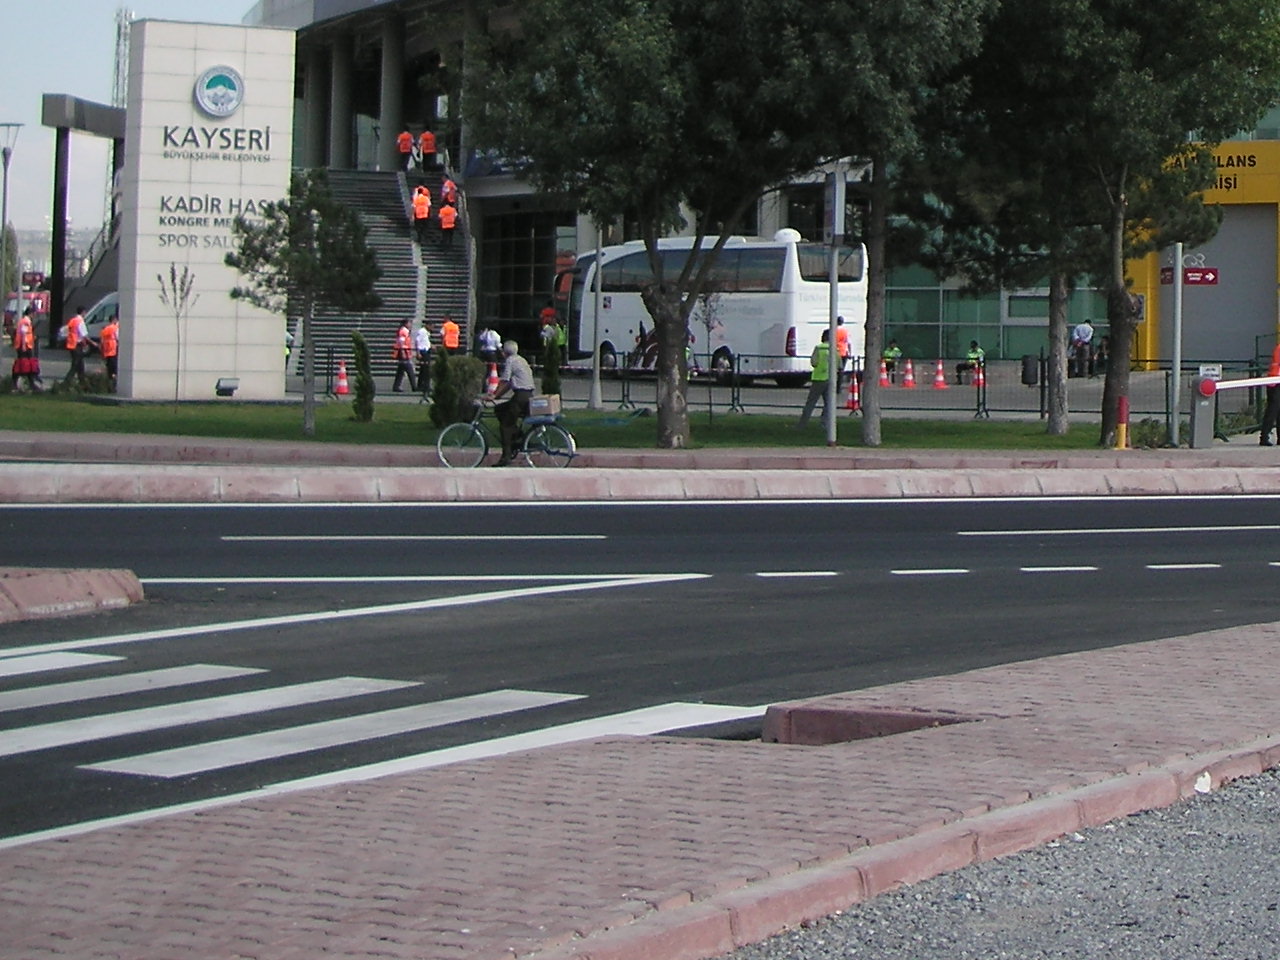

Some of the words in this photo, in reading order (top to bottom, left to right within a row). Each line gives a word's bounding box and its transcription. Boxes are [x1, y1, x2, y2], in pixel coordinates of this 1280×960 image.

[163, 125, 270, 151] KAYSERİ
[1173, 154, 1257, 168] AMLANS
[160, 193, 222, 214] KADİR
[159, 216, 210, 228] KONGRE
[158, 233, 199, 248] SPOR
